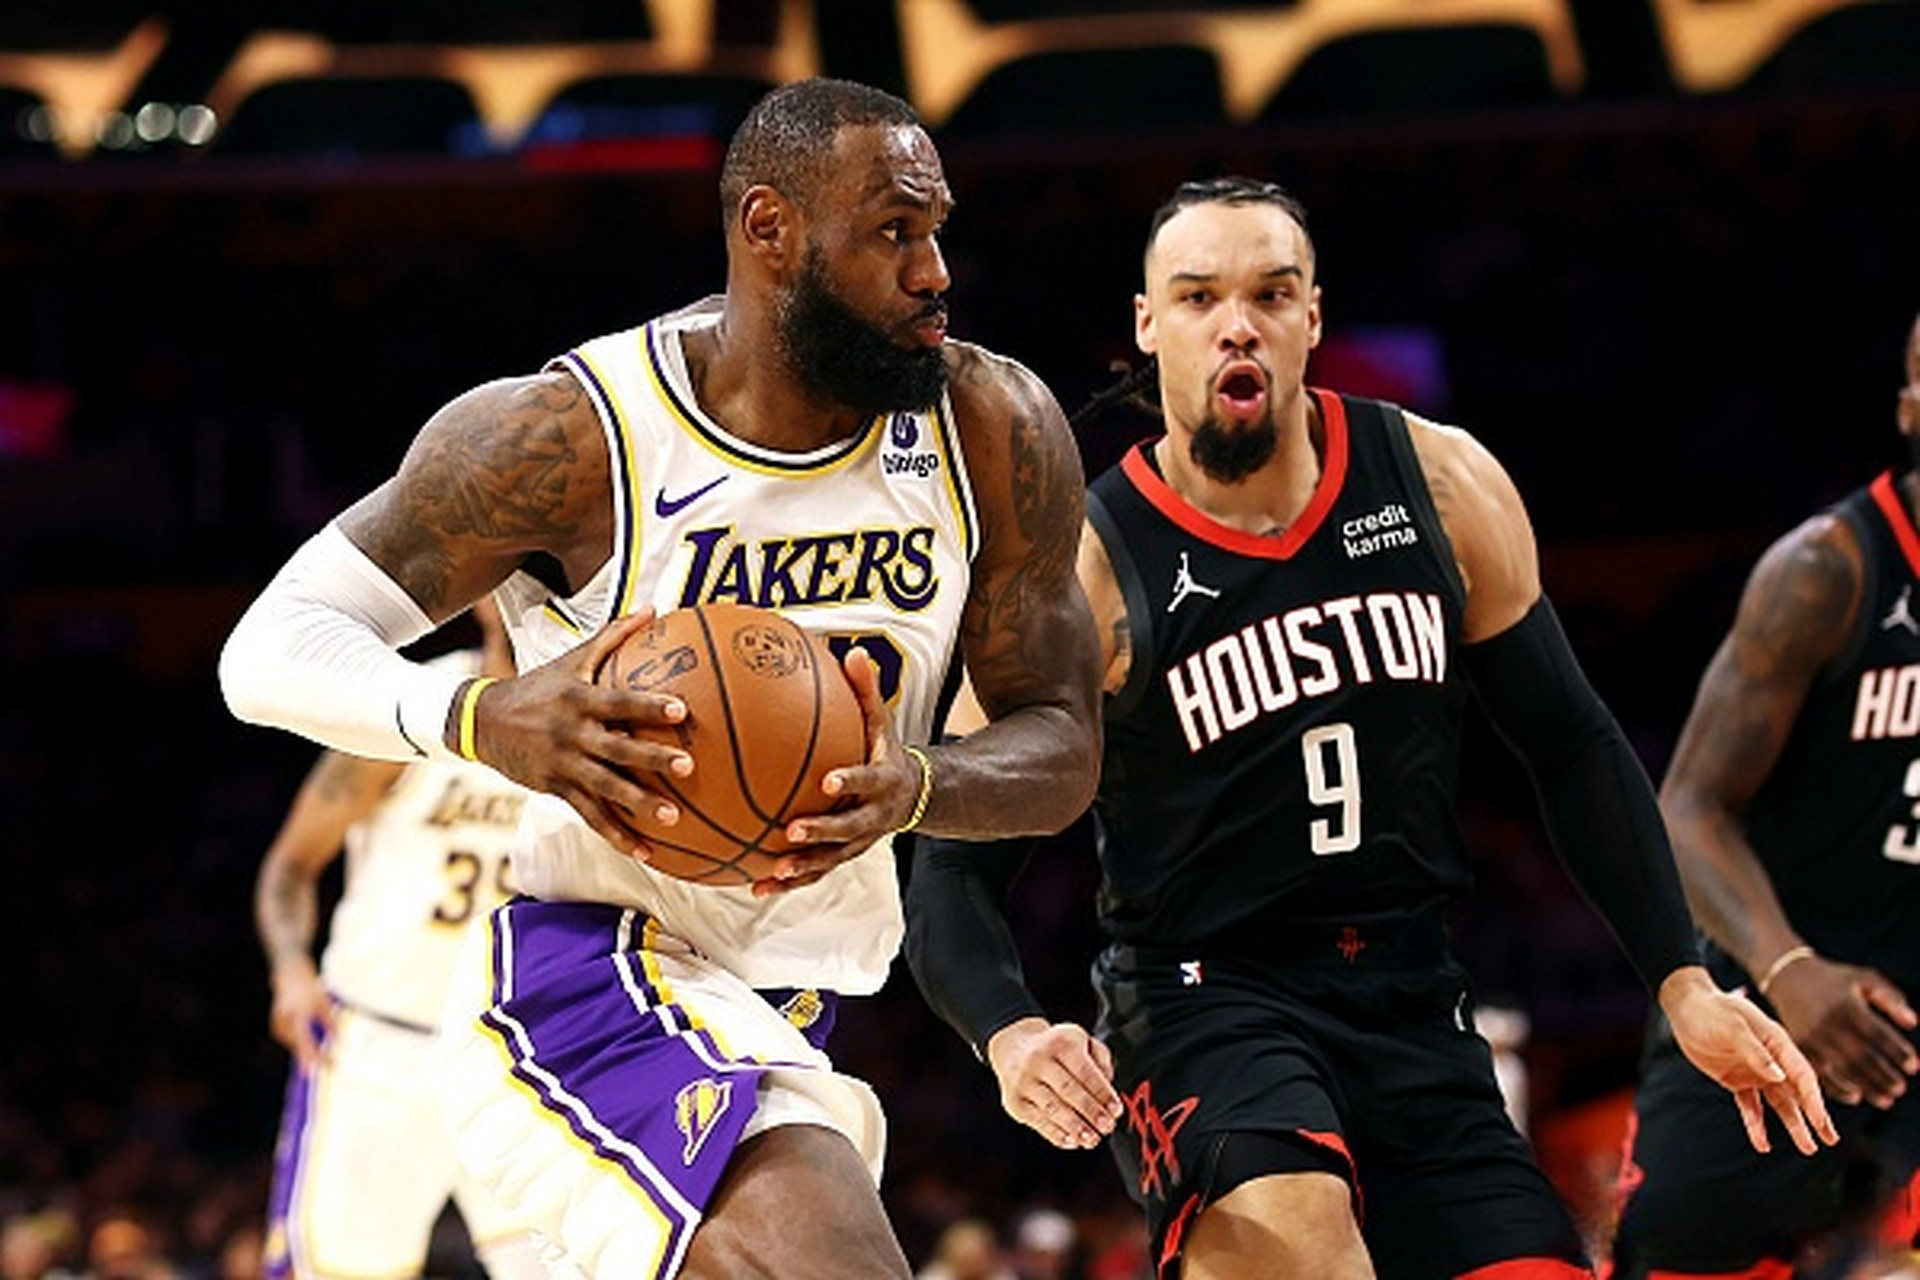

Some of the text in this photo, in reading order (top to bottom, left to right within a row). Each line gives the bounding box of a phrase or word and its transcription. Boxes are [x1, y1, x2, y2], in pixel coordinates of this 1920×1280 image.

[1343, 504, 1411, 538] credit
[1343, 527, 1418, 559] karma
[679, 526, 940, 611] LAKERS
[1166, 592, 1447, 753] HOUSTON
[1302, 722, 1361, 855] 9
